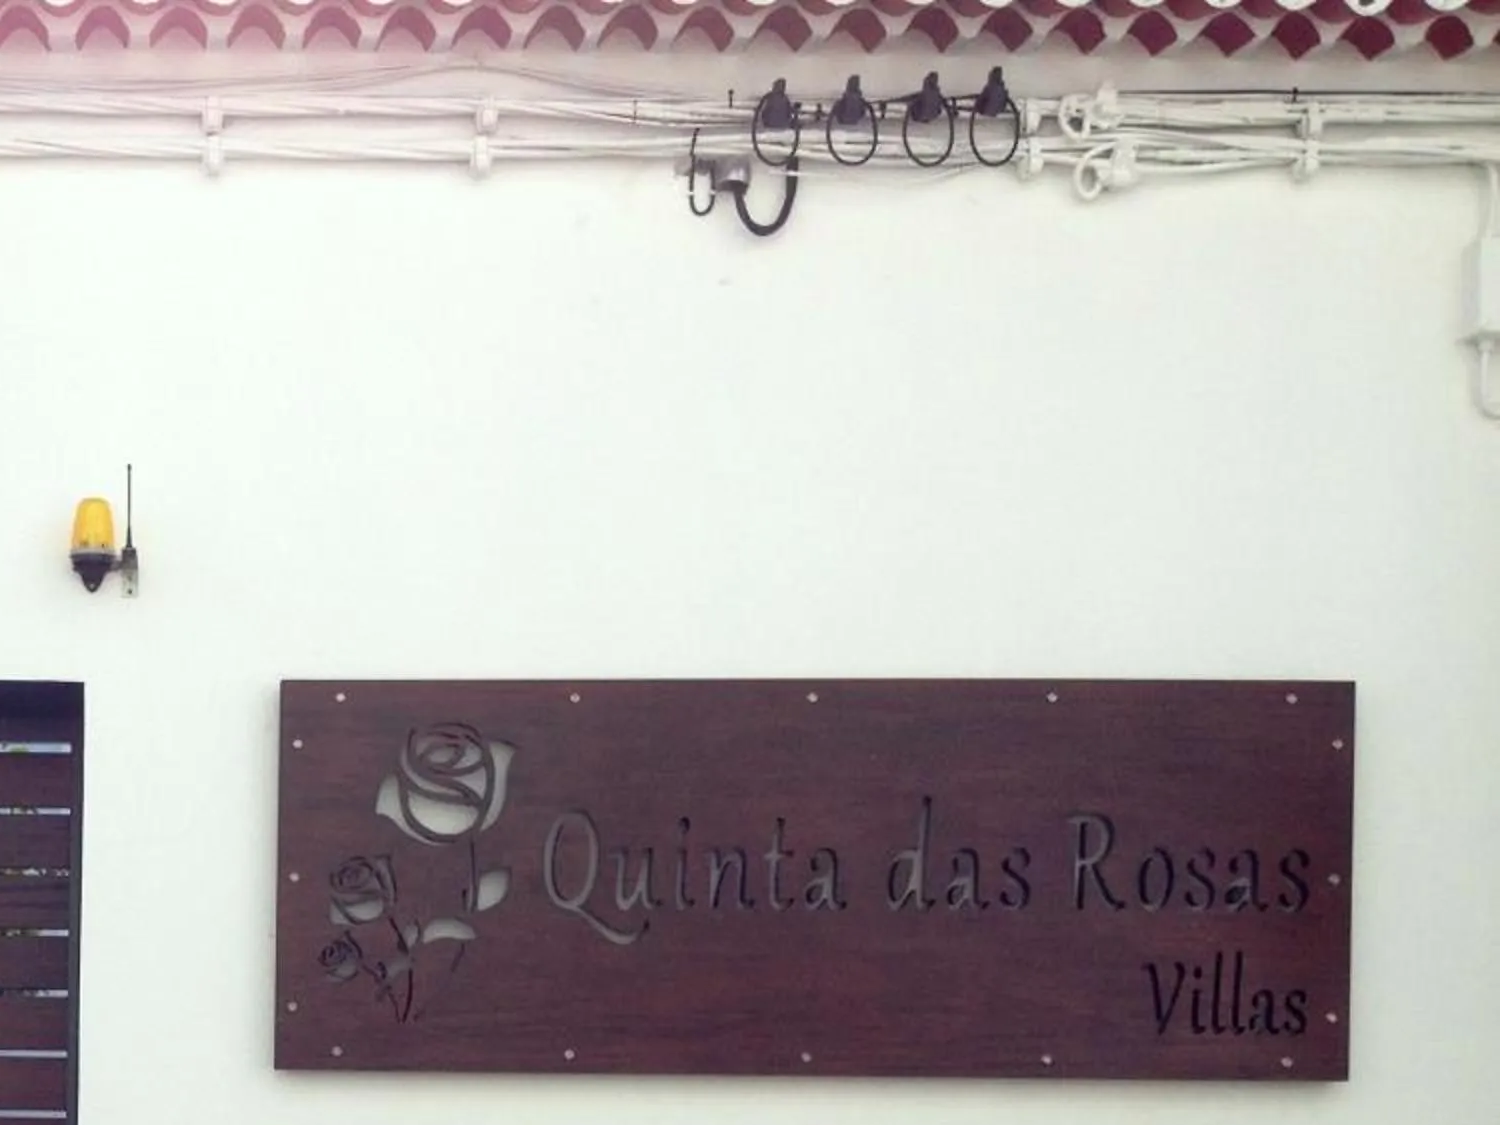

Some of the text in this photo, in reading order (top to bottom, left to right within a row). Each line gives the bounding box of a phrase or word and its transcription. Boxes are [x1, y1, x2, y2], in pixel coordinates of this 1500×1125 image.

[543, 795, 1311, 945] Quinta das Rosas
[1141, 950, 1308, 1036] Villas
